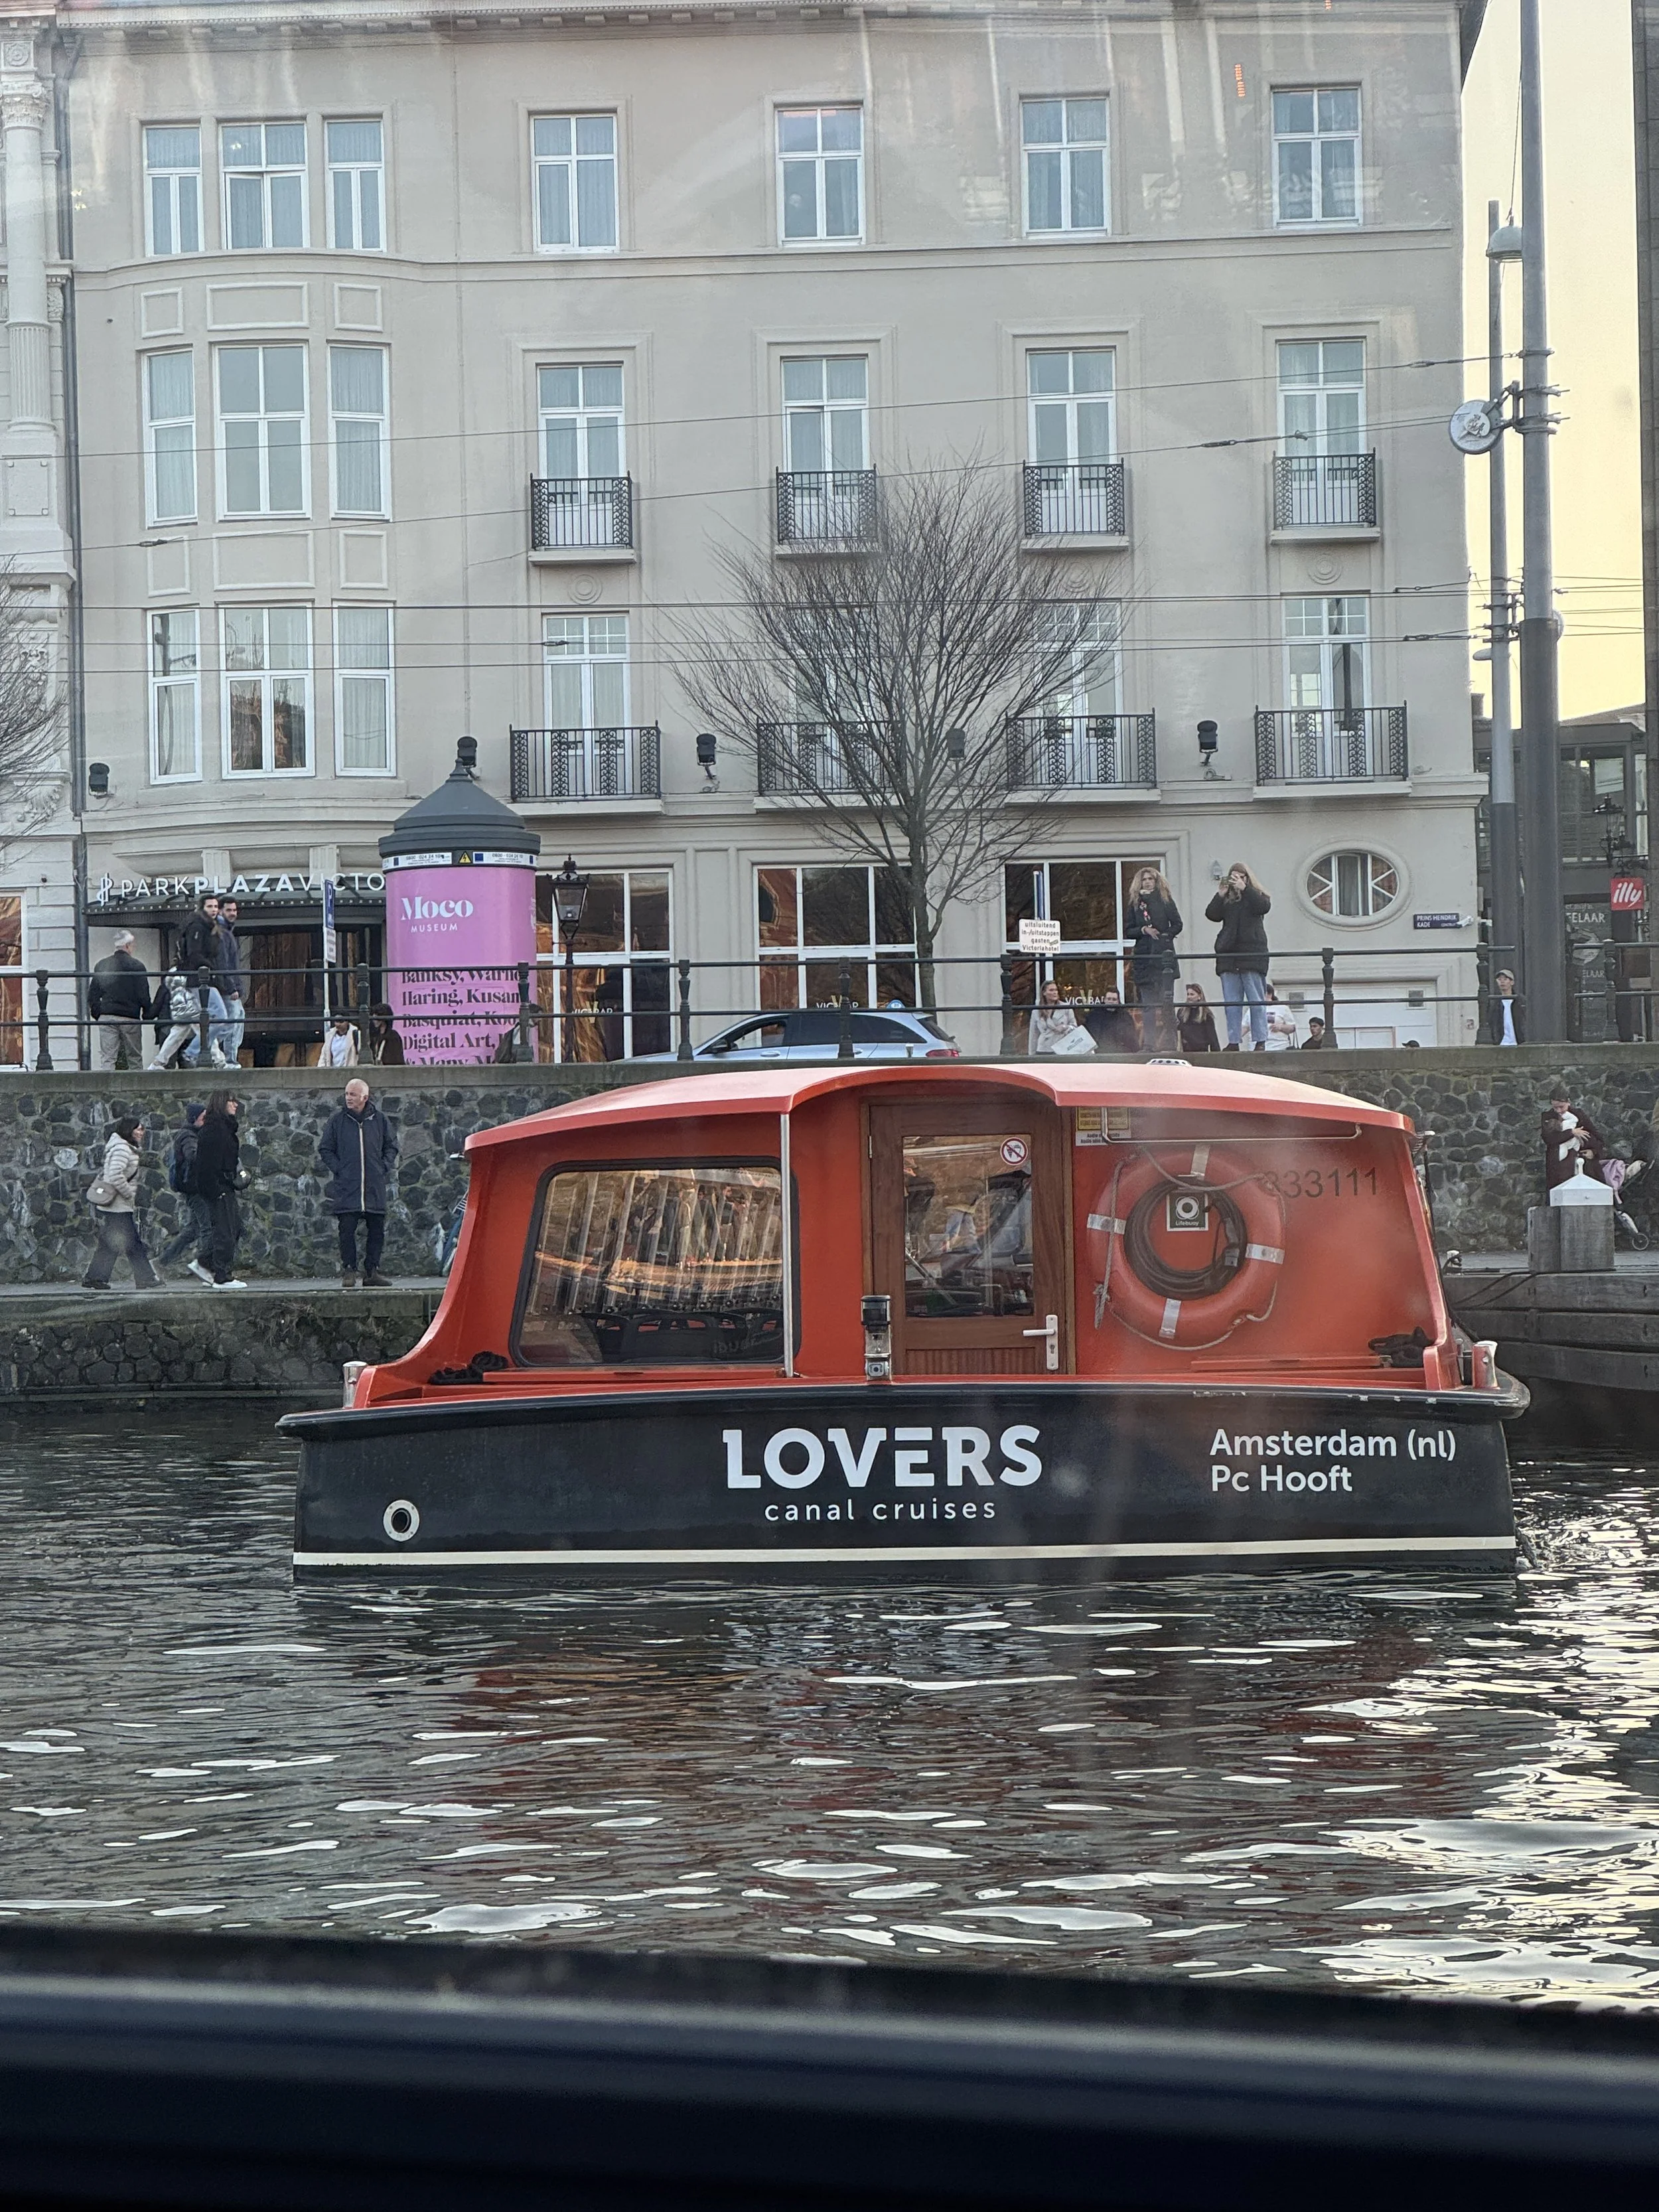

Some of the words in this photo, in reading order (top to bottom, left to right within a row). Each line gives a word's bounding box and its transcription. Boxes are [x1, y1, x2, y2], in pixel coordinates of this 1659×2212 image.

[1613, 881, 1642, 908] illy
[401, 896, 474, 921] Moco
[411, 922, 457, 933] MUSEUM
[402, 988, 463, 1007] Haring,
[403, 1033, 455, 1053] Digital
[460, 1033, 496, 1049] Art,
[723, 1424, 1043, 1489] LOVERS
[1210, 1428, 1397, 1456] Amsterdam
[1407, 1429, 1456, 1461] (nl)
[1212, 1465, 1250, 1492] Pc
[1261, 1464, 1352, 1492] Hooft
[764, 1499, 854, 1521] canal
[872, 1498, 995, 1519] cruises
